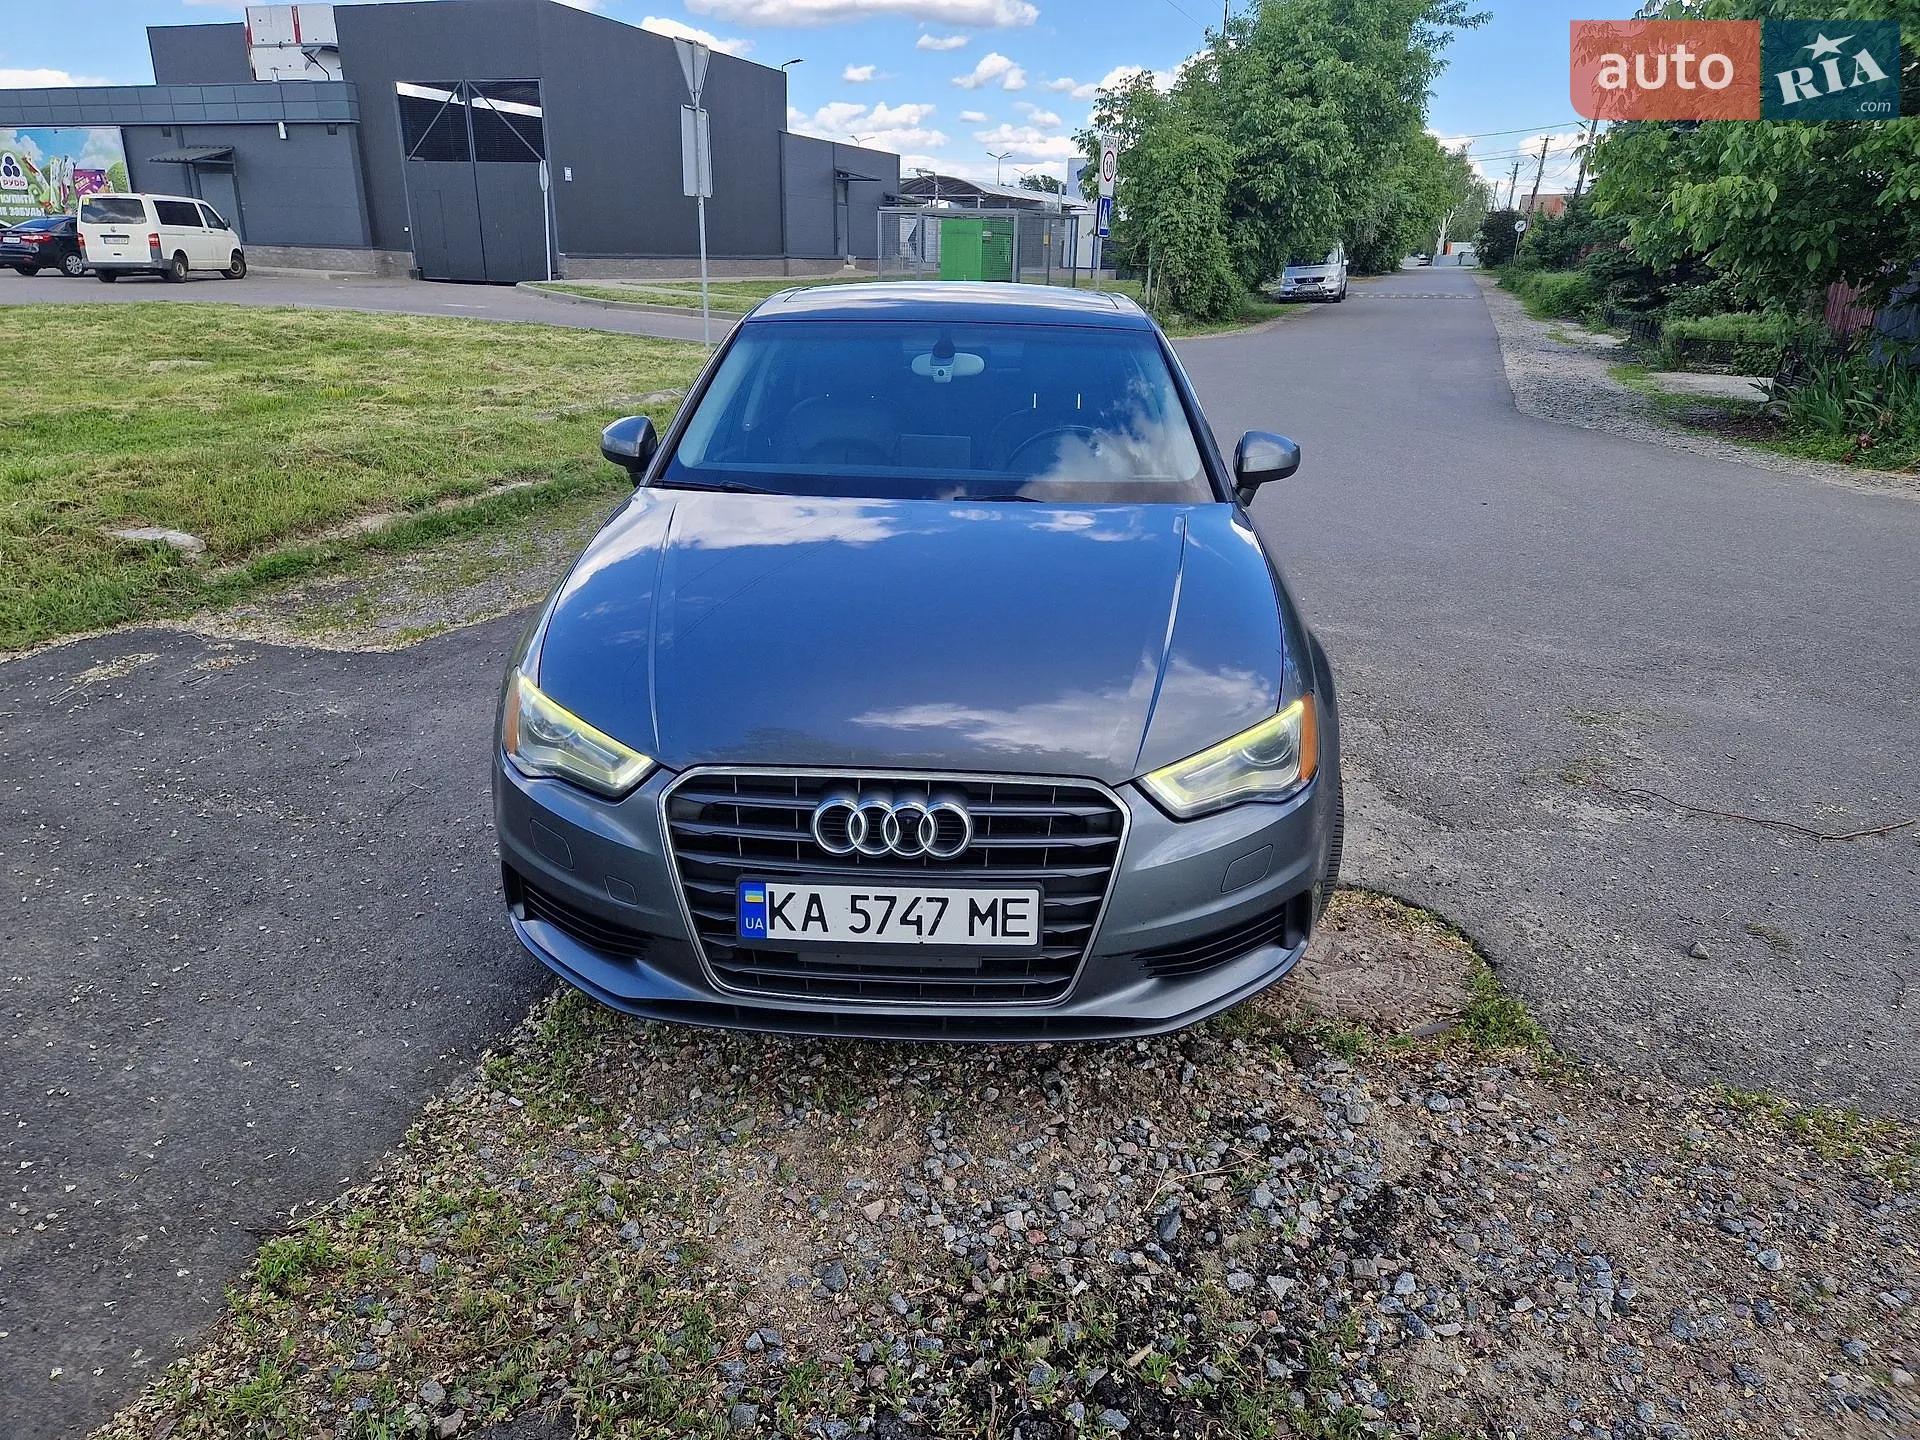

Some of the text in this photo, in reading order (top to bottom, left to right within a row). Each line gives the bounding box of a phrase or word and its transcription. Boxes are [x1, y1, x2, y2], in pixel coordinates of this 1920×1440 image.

[745, 917, 764, 930] UA
[768, 891, 1030, 937] KA 5747 ME
